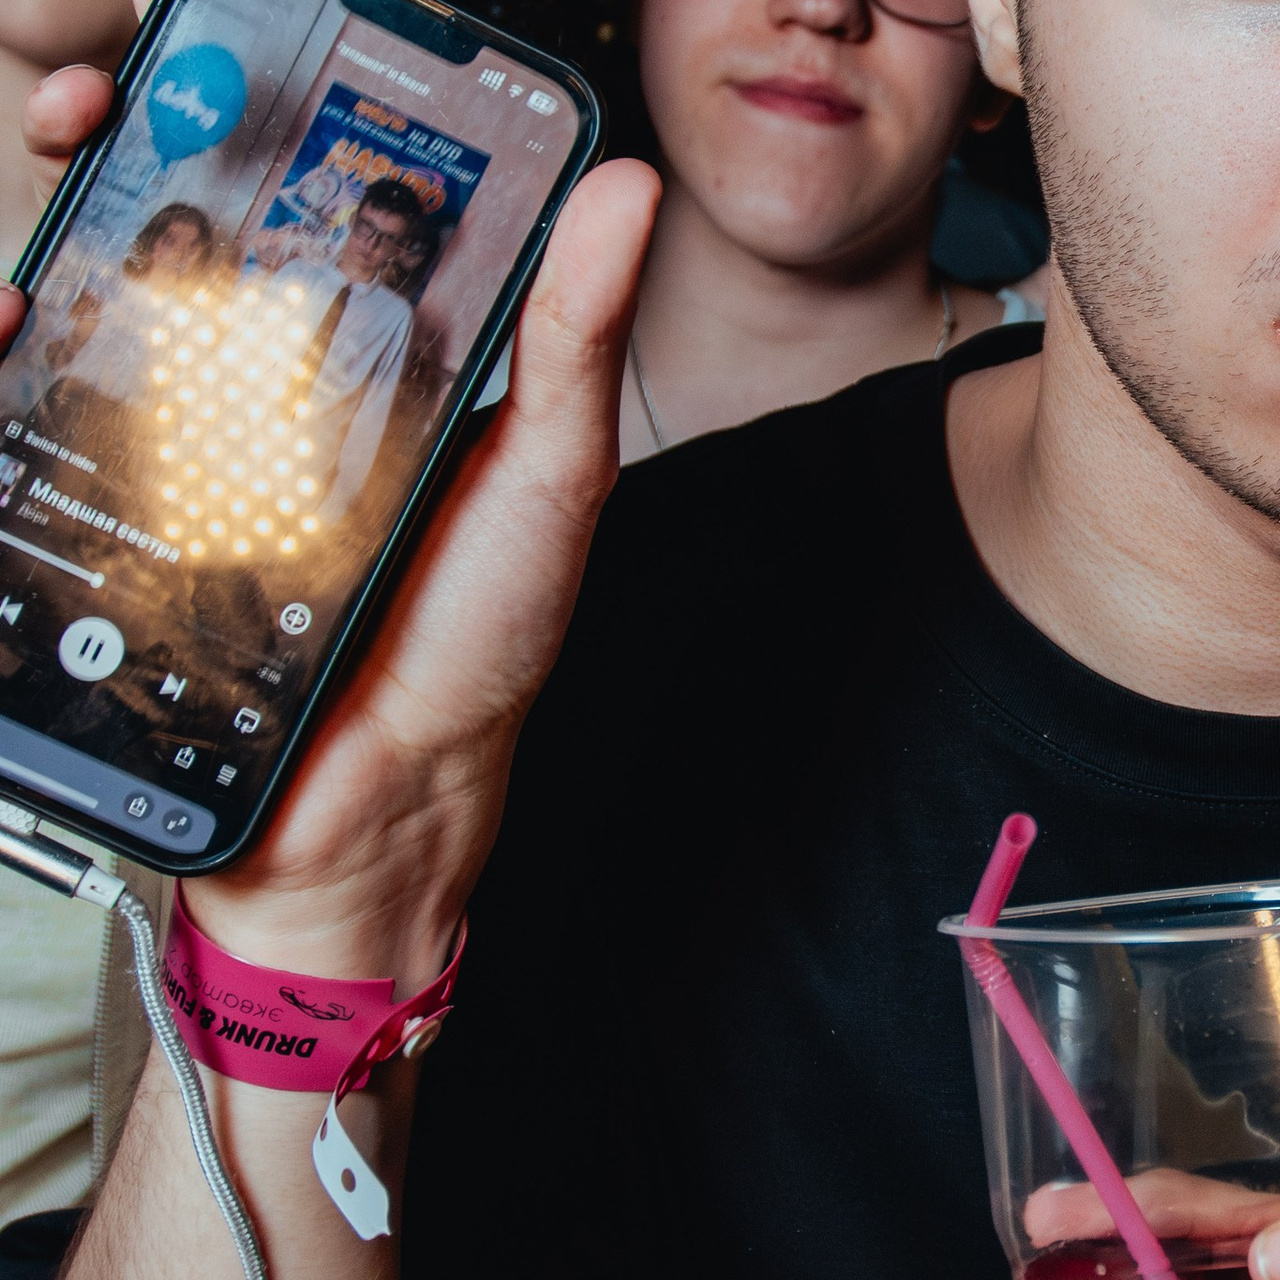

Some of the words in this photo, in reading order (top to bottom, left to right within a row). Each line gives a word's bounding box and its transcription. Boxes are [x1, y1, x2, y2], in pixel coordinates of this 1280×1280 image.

[425, 136, 464, 162] DVD
[23, 429, 59, 456] Switch
[57, 445, 70, 462] to
[69, 451, 98, 474] video
[28, 477, 118, 534] Младшая
[116, 523, 181, 564] сестра
[199, 1005, 216, 1030] &
[216, 1016, 318, 1058] DRUNK
